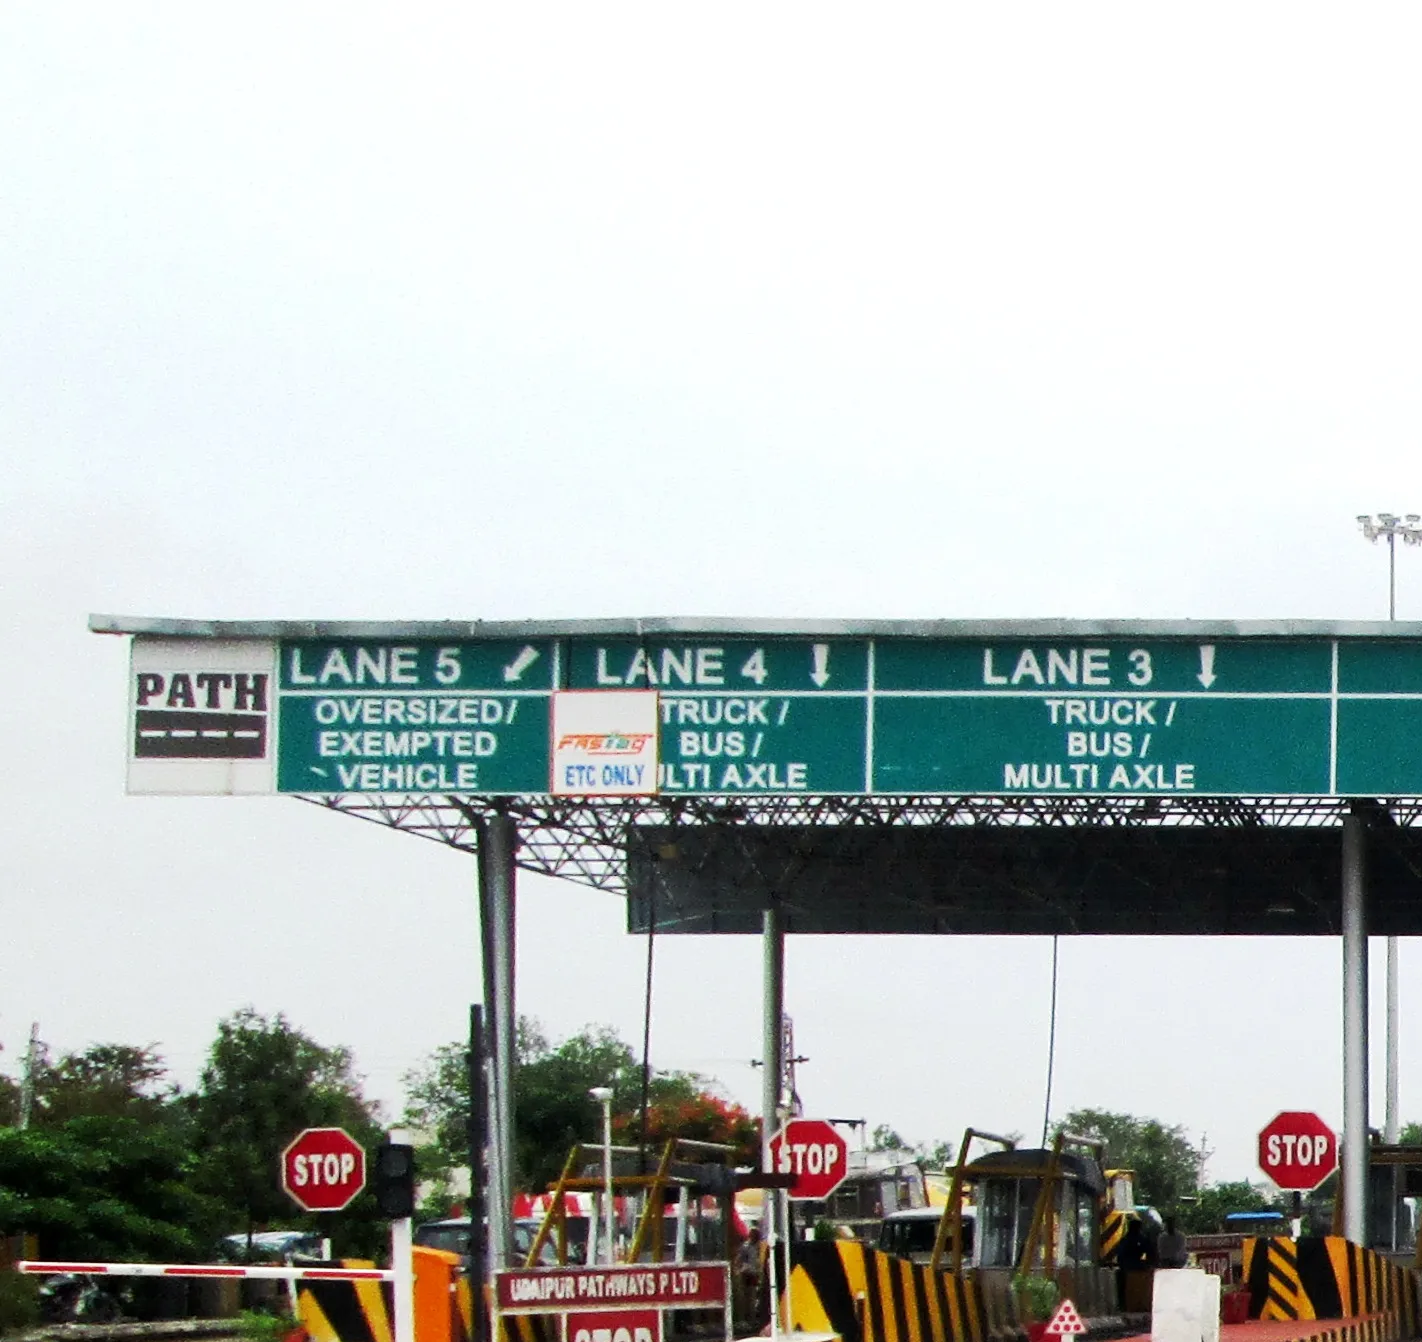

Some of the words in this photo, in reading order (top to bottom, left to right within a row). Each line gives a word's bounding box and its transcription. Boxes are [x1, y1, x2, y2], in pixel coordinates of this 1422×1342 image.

[291, 648, 418, 683] LANE
[436, 649, 460, 683] 5
[597, 649, 724, 684] LANE
[742, 650, 768, 684] 4
[984, 649, 1110, 685] LANE
[1128, 650, 1152, 685] 3
[136, 673, 268, 711] PATH
[661, 700, 767, 724] TRUCK
[1045, 700, 1155, 725] TRUCK
[319, 731, 496, 756] EXEMPTED
[680, 732, 744, 756] BUS
[1068, 732, 1132, 757] BUS
[338, 765, 478, 789] VEHICLE
[566, 765, 594, 786] ETC
[603, 765, 643, 785] ONLY
[659, 765, 710, 788] LTI
[722, 764, 806, 788] AXLE
[1005, 764, 1098, 788] MULTI
[1109, 765, 1194, 789] AXLE
[779, 1144, 838, 1174] STOP
[1268, 1135, 1327, 1165] STOP
[295, 1154, 354, 1185] STOP
[511, 1277, 575, 1301] UDAIPUR
[578, 1273, 654, 1297] PATHWAYS
[660, 1273, 668, 1293] P
[673, 1272, 698, 1293] LTD
